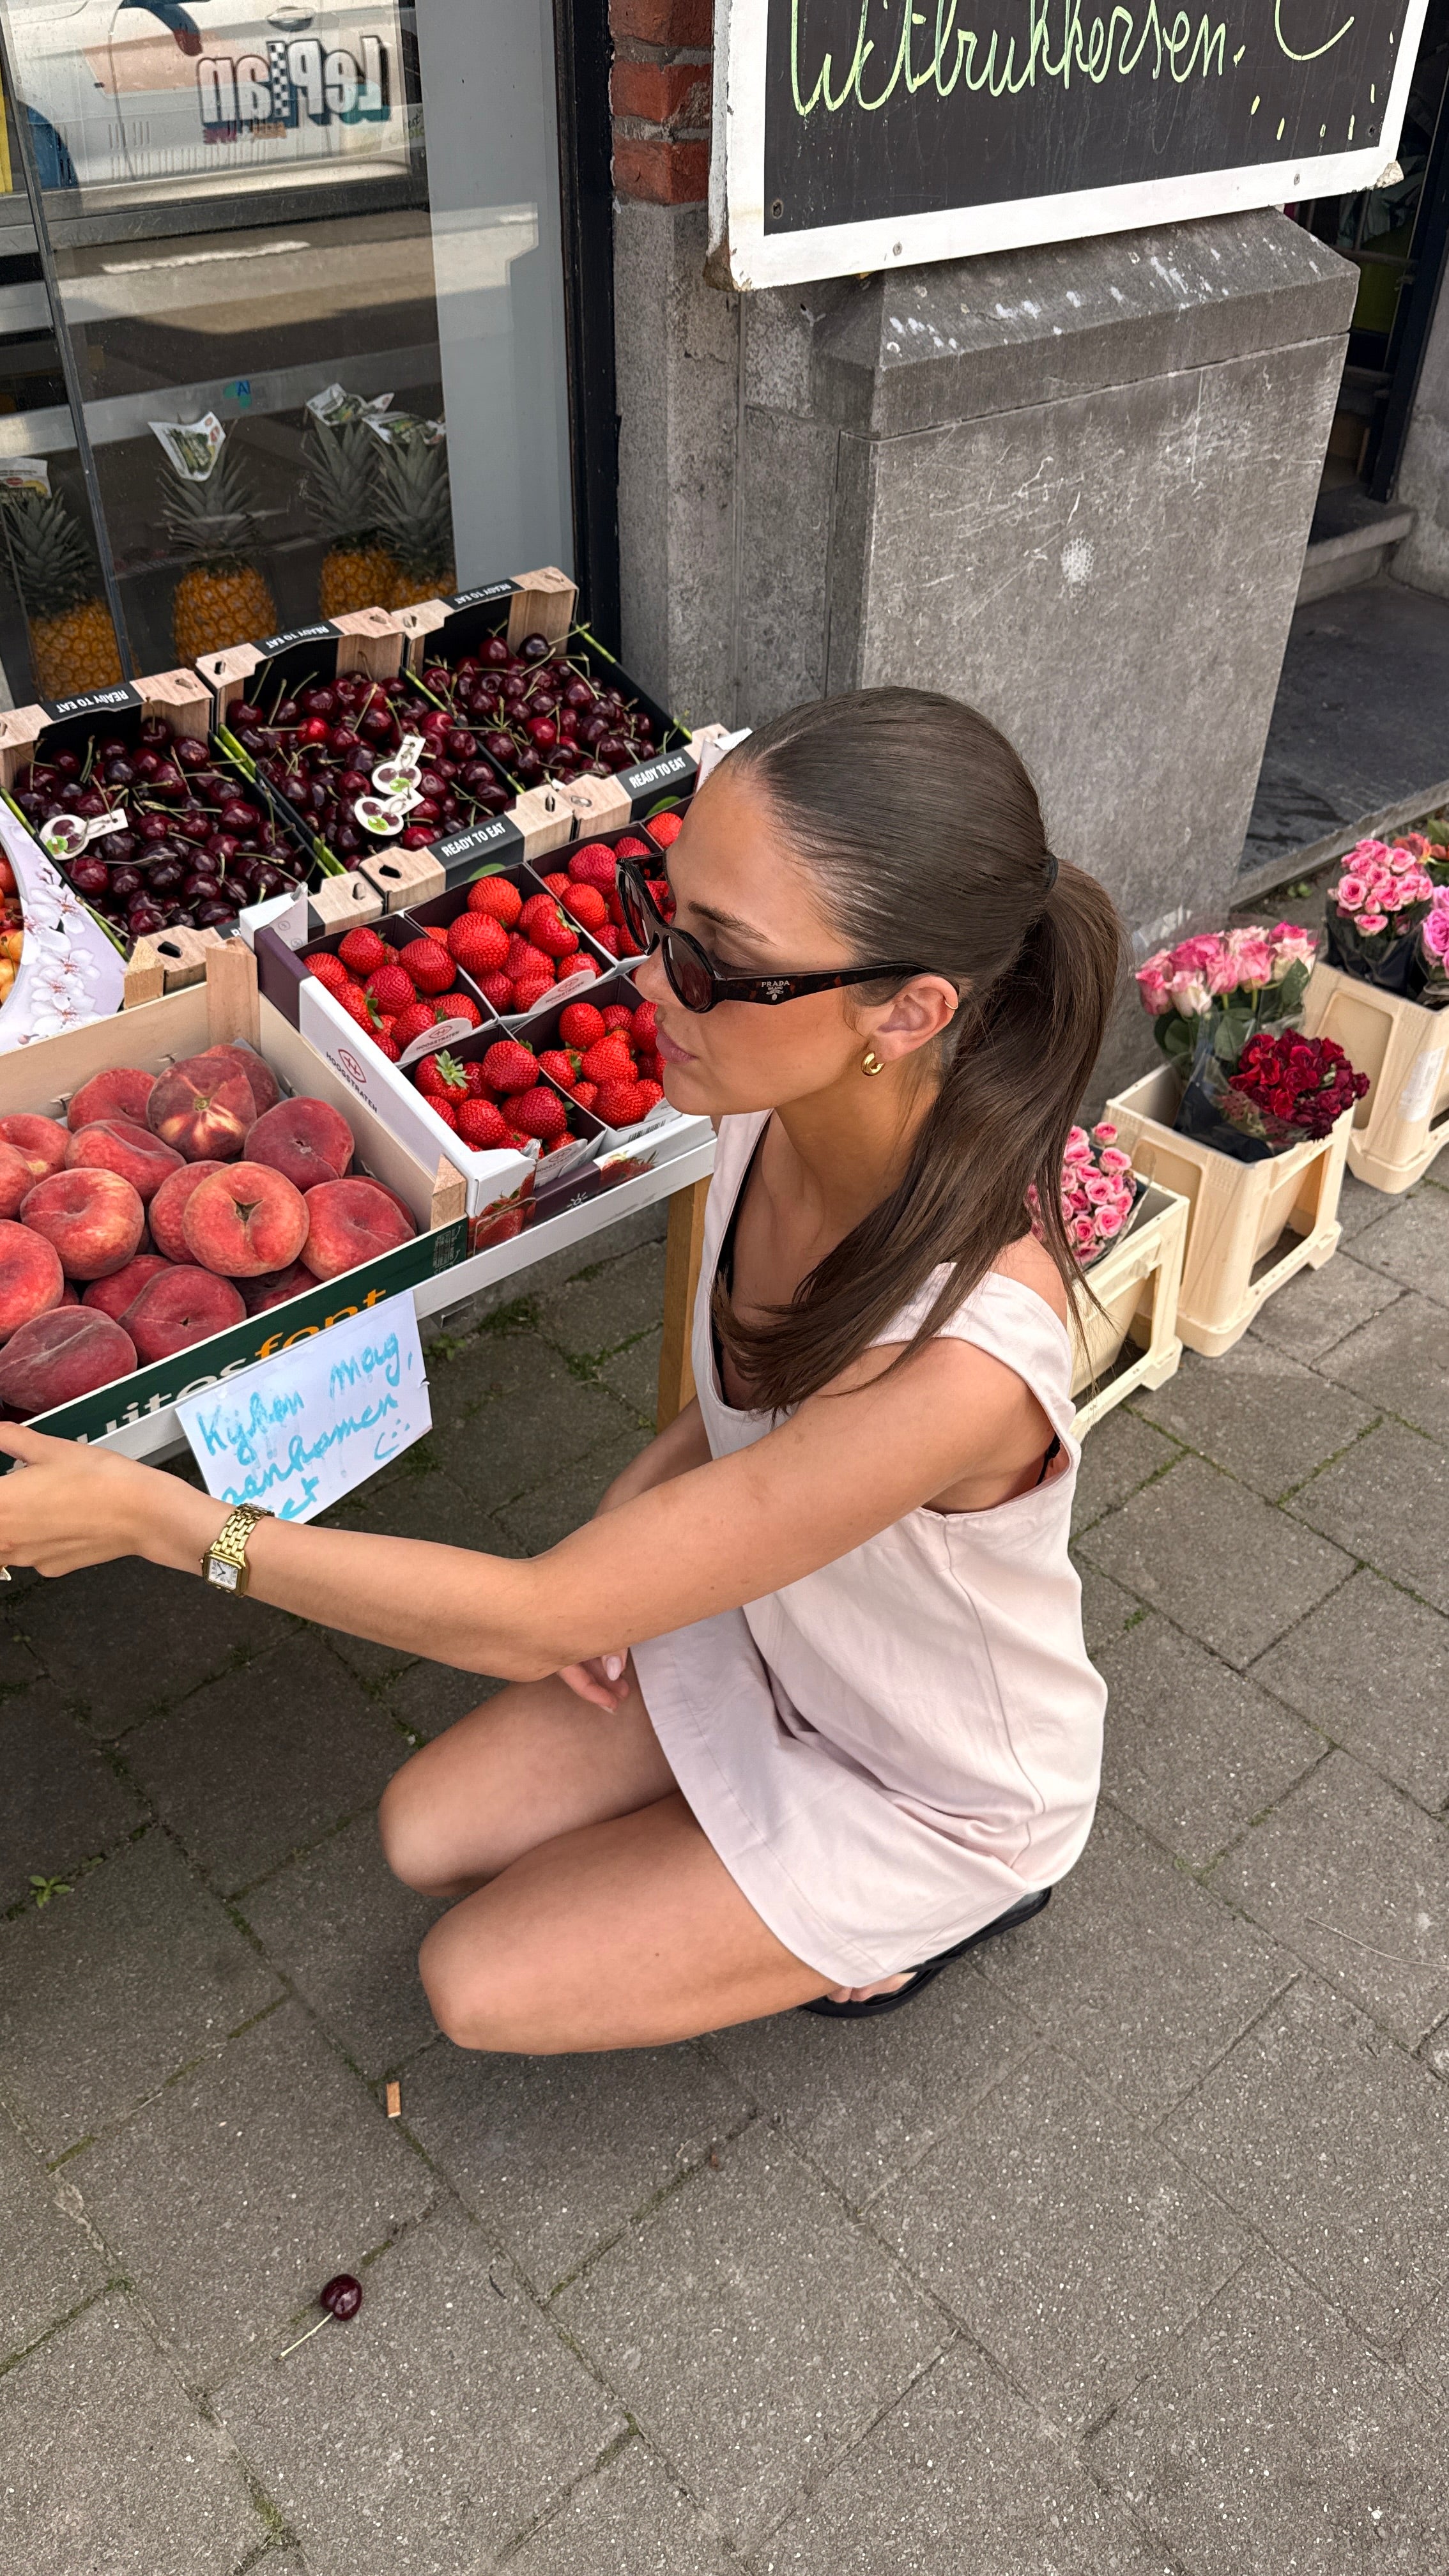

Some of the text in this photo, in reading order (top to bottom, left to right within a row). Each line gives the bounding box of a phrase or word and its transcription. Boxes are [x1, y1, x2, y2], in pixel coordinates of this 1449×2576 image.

[454, 595, 472, 604] EAT
[482, 583, 512, 595] READY
[265, 625, 330, 649] READY TO EAT
[56, 689, 129, 714] READY TO EAT
[629, 756, 686, 789] READY TO EAT
[441, 822, 506, 857] READY TO EAT
[326, 1051, 377, 1114] HOOGSTRATEN
